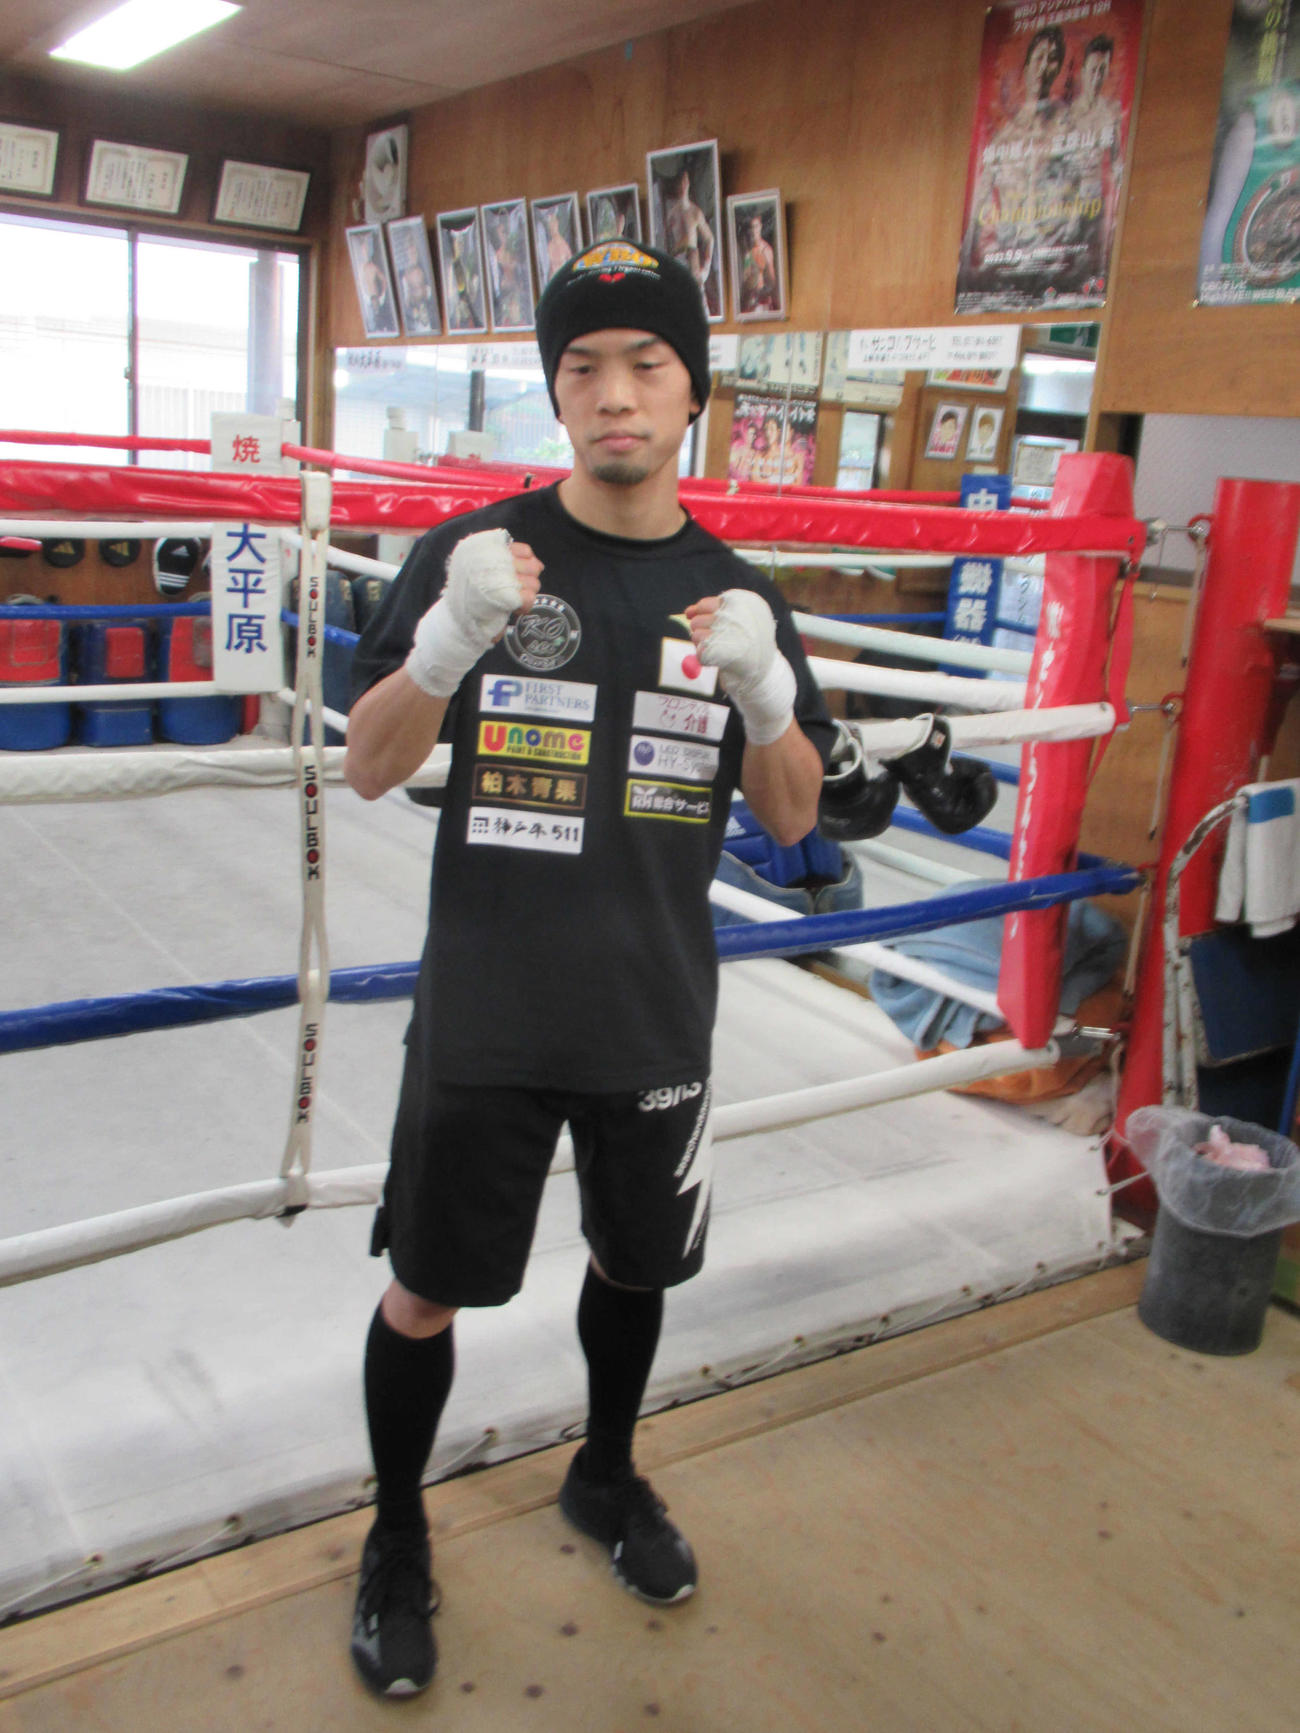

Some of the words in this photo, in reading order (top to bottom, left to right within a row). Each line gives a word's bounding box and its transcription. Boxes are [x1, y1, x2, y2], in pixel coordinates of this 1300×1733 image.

[232, 434, 261, 464] 焼
[225, 522, 267, 654] 大平原
[525, 681, 563, 695] FIRST
[524, 693, 591, 711] PARTNERS
[551, 823, 580, 843] 511
